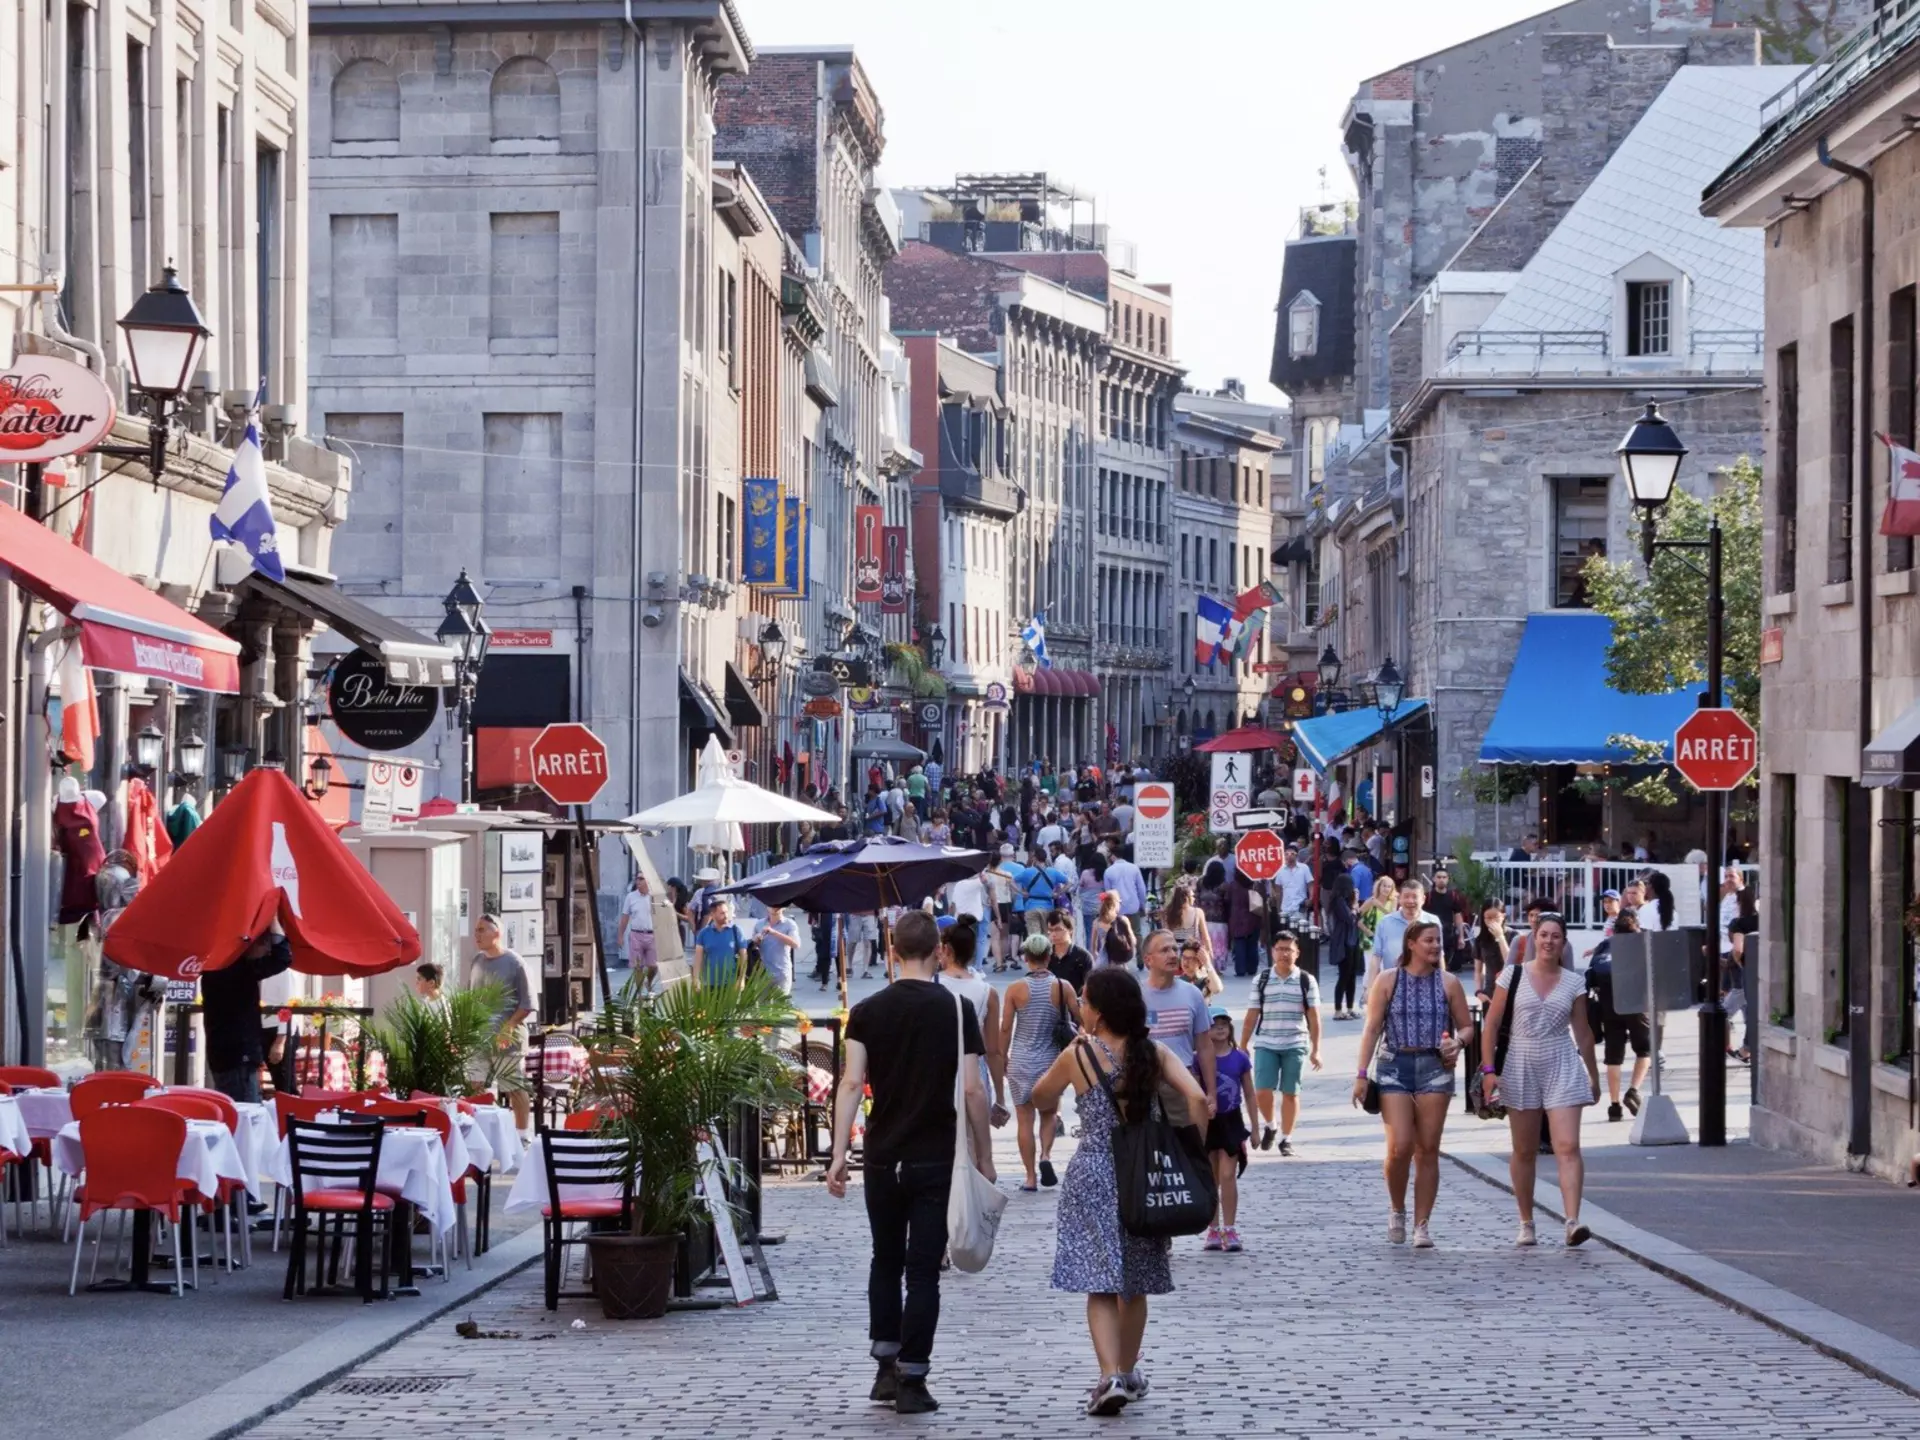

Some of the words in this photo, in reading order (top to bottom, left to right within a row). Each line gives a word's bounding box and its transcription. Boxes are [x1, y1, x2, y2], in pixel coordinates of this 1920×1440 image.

[0, 407, 96, 434] ateur
[337, 673, 395, 708] Bella
[395, 684, 425, 707] Vita
[1680, 733, 1753, 761] ARRÊT
[537, 748, 603, 776] ARRÊT
[1239, 844, 1283, 863] ARRÊT
[1147, 1171, 1186, 1187] WTH
[1145, 1190, 1193, 1208] STEVE
